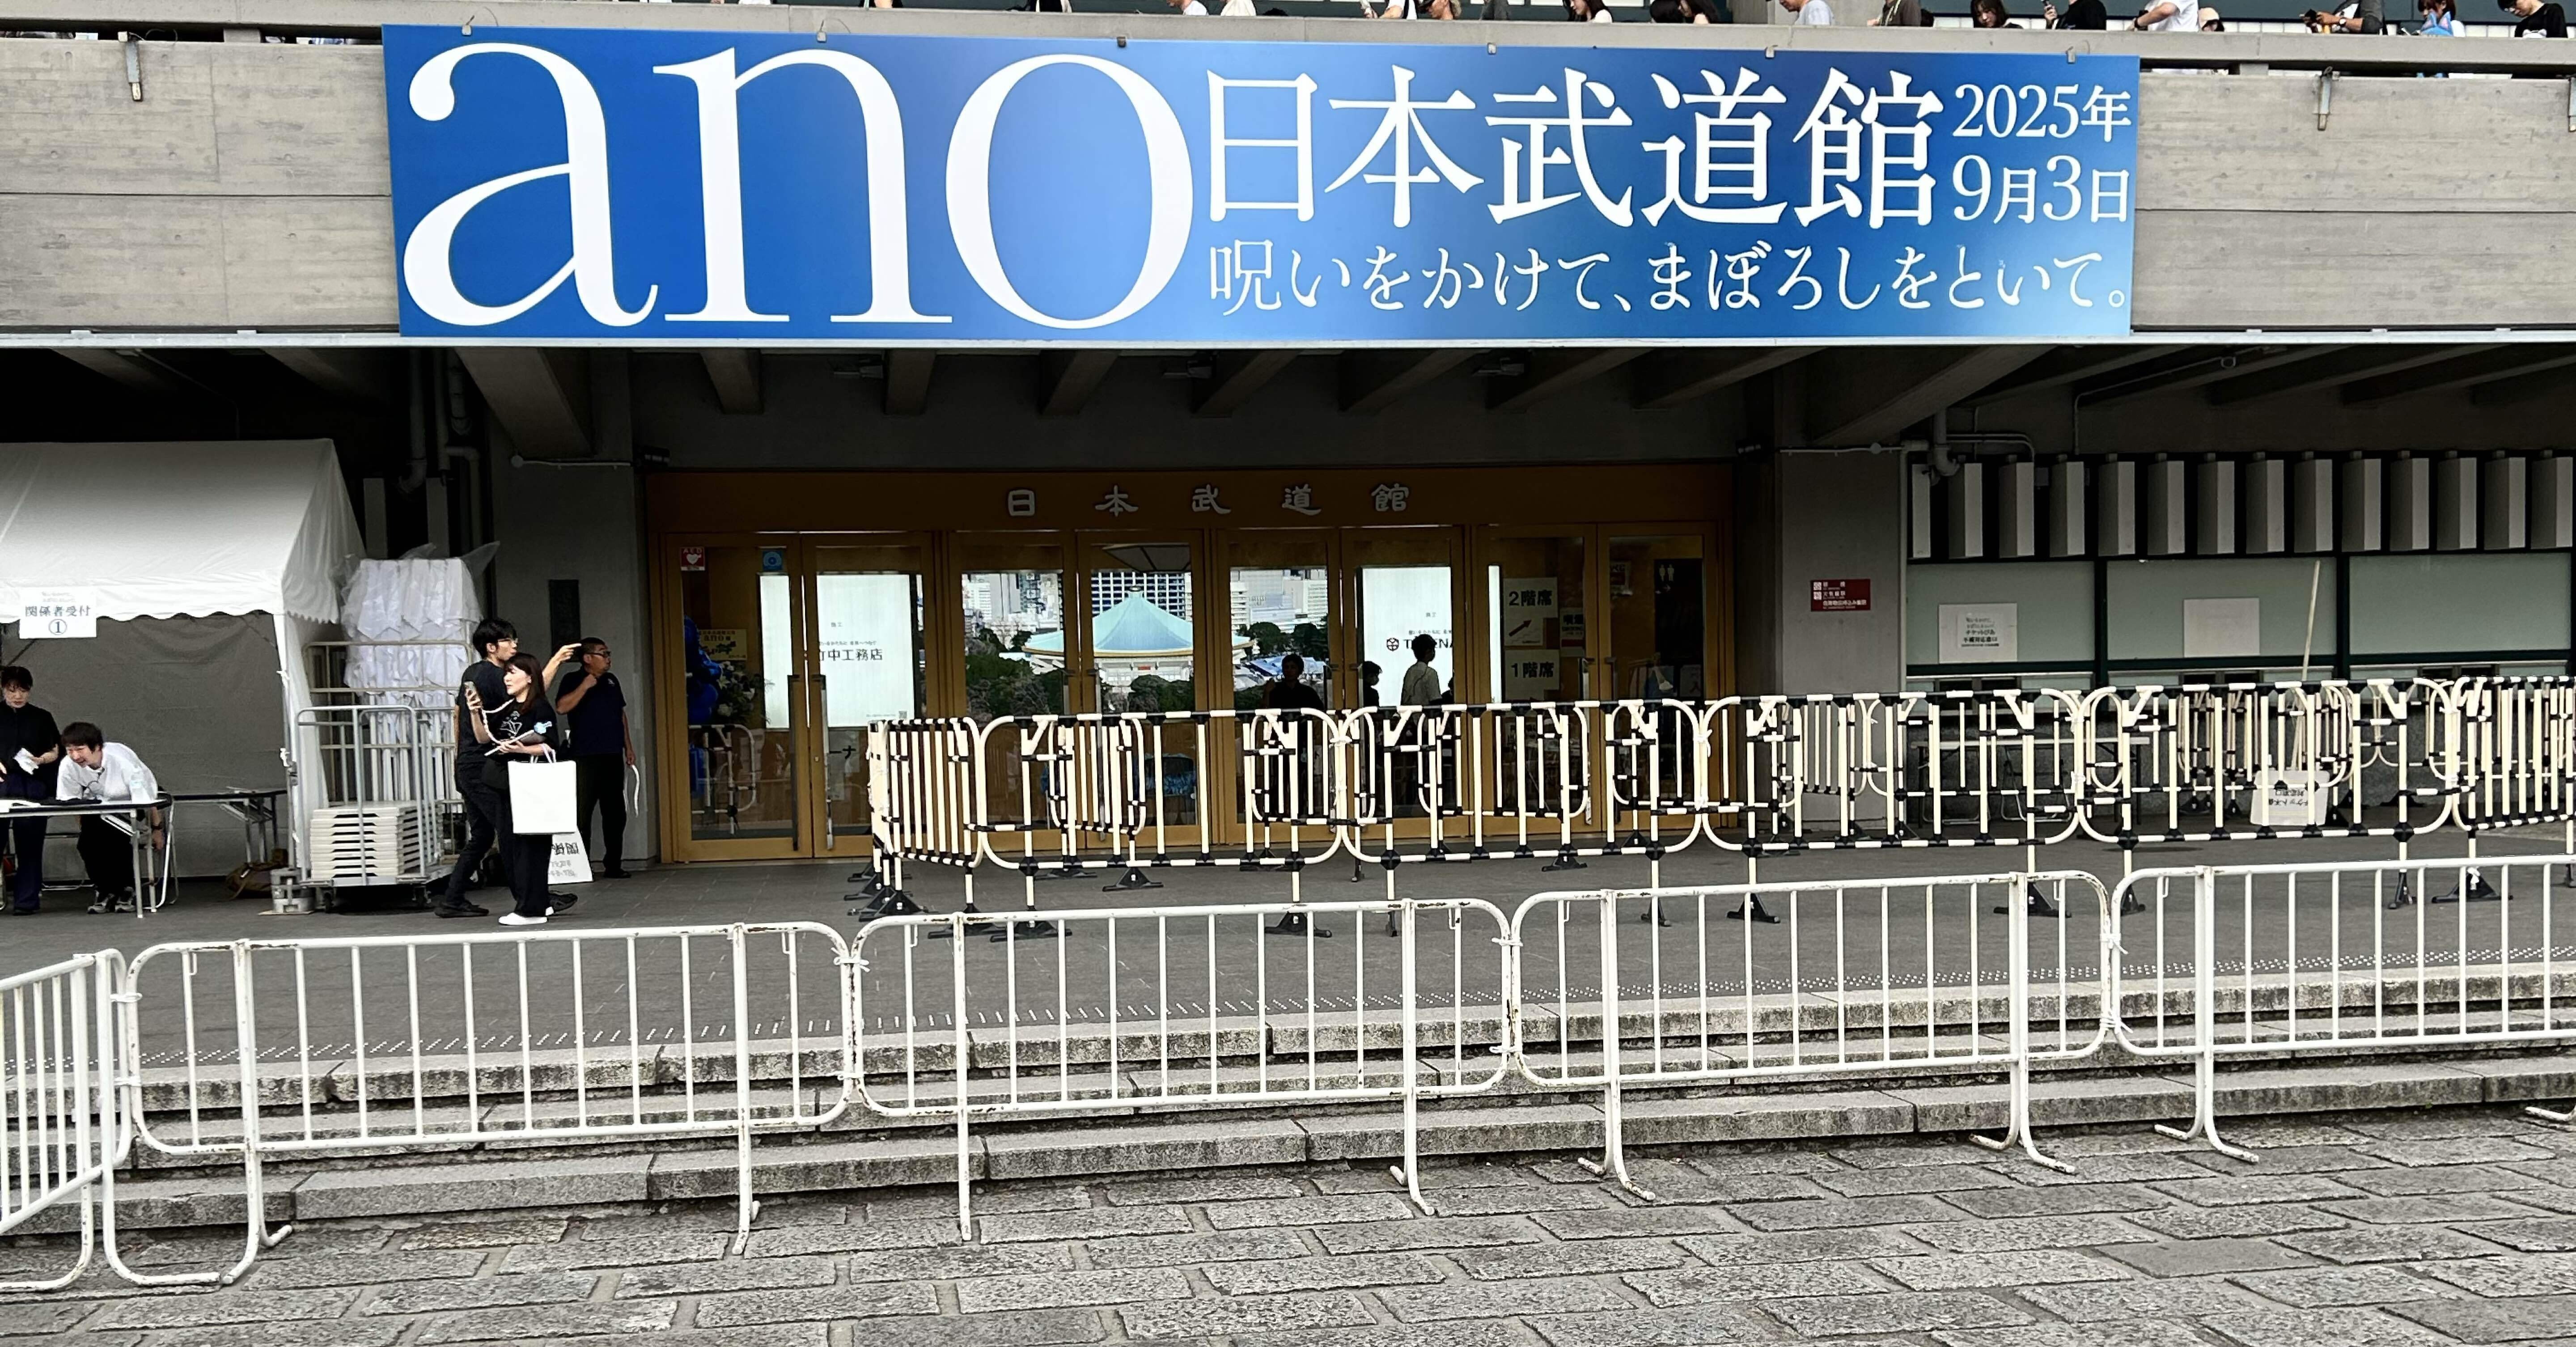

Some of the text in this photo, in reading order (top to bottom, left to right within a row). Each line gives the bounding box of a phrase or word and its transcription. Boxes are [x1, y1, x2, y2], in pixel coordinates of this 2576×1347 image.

[1953, 84, 2131, 142] 2025年
[1207, 65, 1944, 228] 日本武道館
[404, 43, 1193, 328] ano
[1953, 155, 2129, 223] 9月3日
[1210, 239, 2126, 316] 呪いをかけて、まぼろしをといて。
[1007, 483, 1411, 518] 日本武道館
[25, 605, 91, 617] 関係者受付
[1508, 589, 1553, 607] 2階席
[1511, 661, 1555, 679] 1階席
